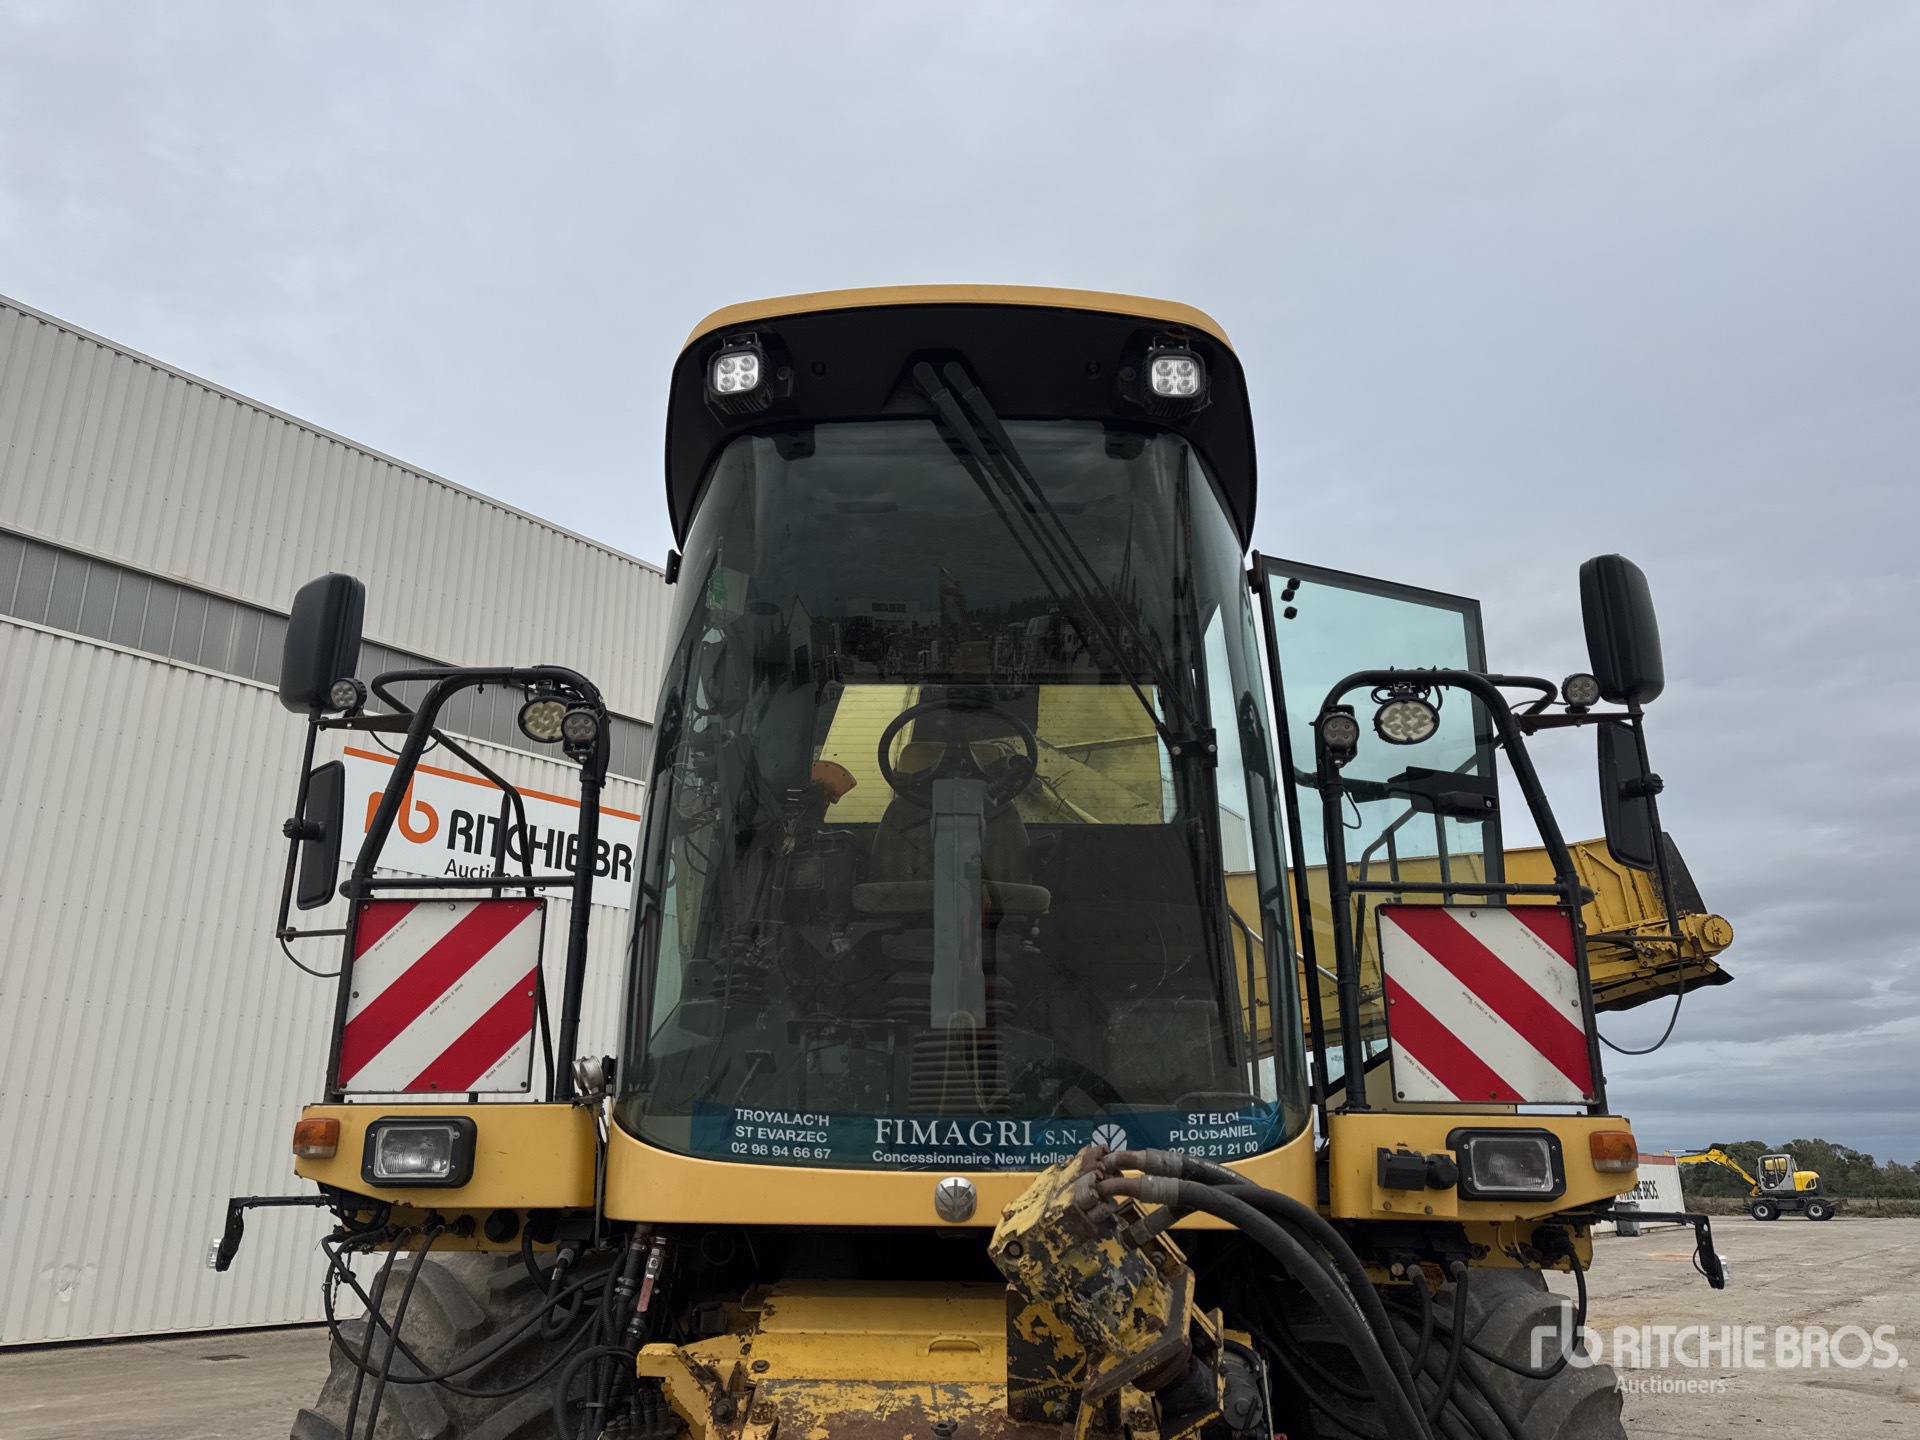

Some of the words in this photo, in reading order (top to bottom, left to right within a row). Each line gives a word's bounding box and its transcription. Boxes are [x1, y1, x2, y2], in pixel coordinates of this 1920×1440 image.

[734, 1108, 830, 1127] TROYALAC'H
[1187, 1113, 1206, 1125] ST
[735, 1126, 754, 1138] ST
[757, 1128, 828, 1143] EVARZEC
[874, 1118, 1034, 1147] FIMAGRI
[731, 1142, 748, 1154] 02
[751, 1144, 768, 1155] 98
[772, 1146, 789, 1157] 94
[793, 1147, 811, 1158] 66
[814, 1148, 832, 1159] 67
[872, 1150, 991, 1165] Concessionnaire
[995, 1153, 1026, 1165] New
[1030, 1153, 1076, 1165] Holla
[1189, 1146, 1206, 1157] 98
[1209, 1145, 1223, 1156] 21
[1227, 1143, 1241, 1155] 21
[1244, 1141, 1259, 1153] 00
